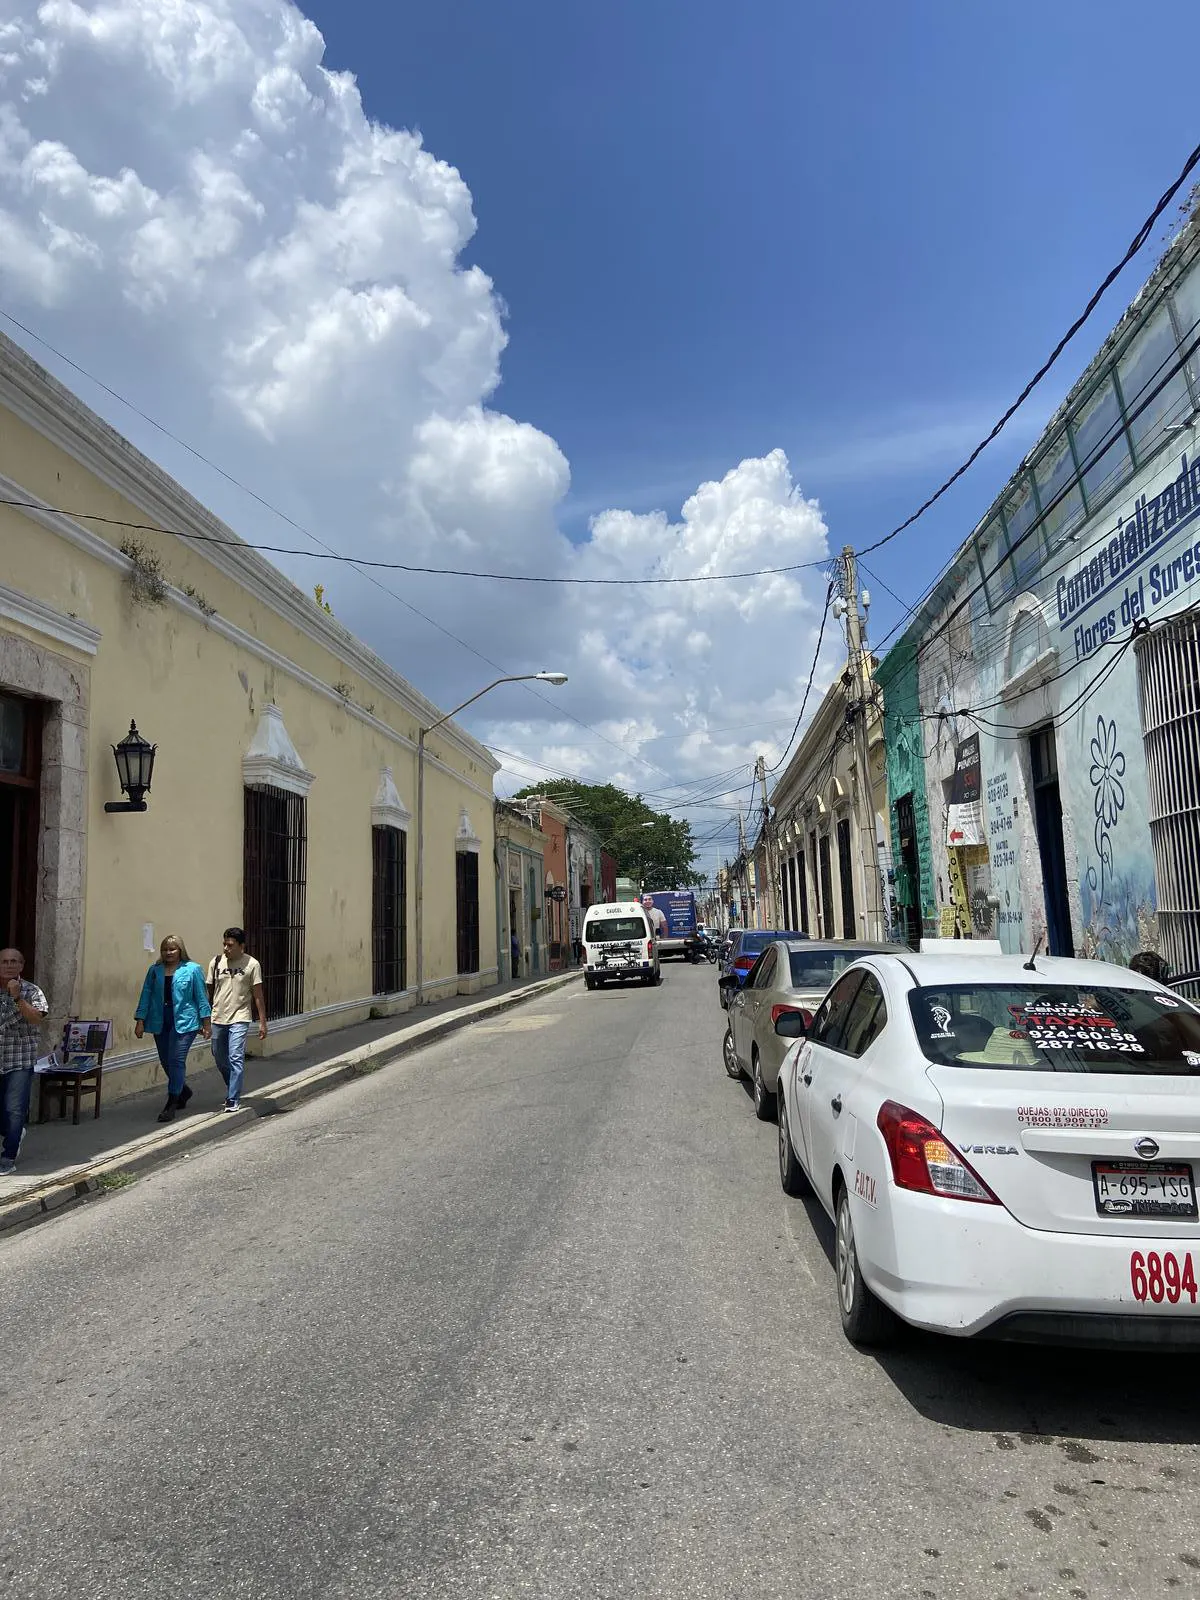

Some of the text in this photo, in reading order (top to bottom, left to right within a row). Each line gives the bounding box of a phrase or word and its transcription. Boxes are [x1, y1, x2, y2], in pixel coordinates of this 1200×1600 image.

[1073, 608, 1116, 661] Flores
[1120, 575, 1146, 626] del
[1023, 1006, 1104, 1015] CENTRAL
[1026, 1015, 1117, 1028] TAXIS
[1029, 1030, 1138, 1043] 924-60-58
[1035, 1040, 1145, 1053] 287-16-28
[1017, 1106, 1108, 1118] QUEJAS: 072 (DIRECTO)
[958, 1143, 1020, 1156] VERSA
[1100, 1174, 1190, 1198] A-695-YSG
[1130, 1251, 1198, 1304] 6894
